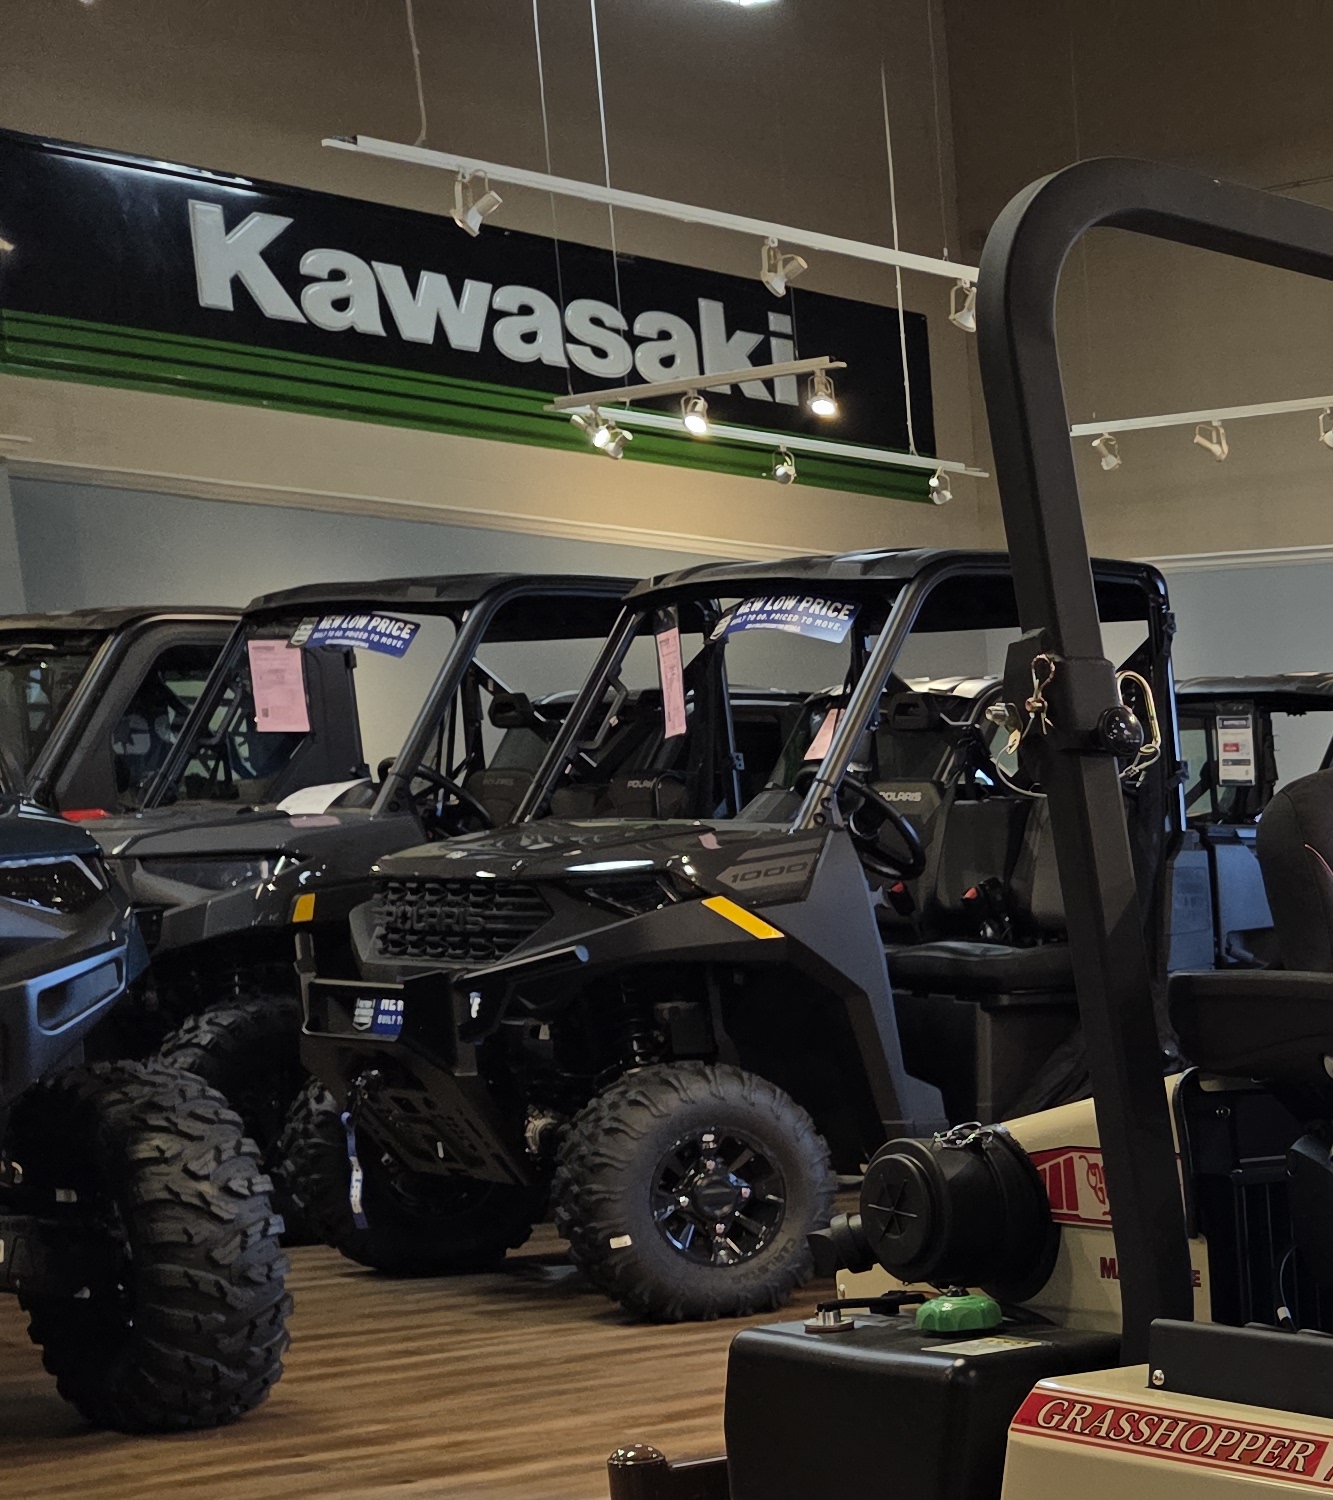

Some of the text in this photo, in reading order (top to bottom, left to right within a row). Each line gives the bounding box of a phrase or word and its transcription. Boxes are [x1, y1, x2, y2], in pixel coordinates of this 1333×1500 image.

[187, 198, 803, 408] Kawasaki
[737, 595, 855, 621] NEW LOW PRICE
[770, 613, 799, 622] PRICED
[800, 615, 812, 625] TO
[318, 614, 415, 640] NEW LOW PRICE
[369, 633, 378, 643] TO
[730, 861, 809, 884] 1000
[1036, 1398, 1317, 1476] GRASSHOPPER
